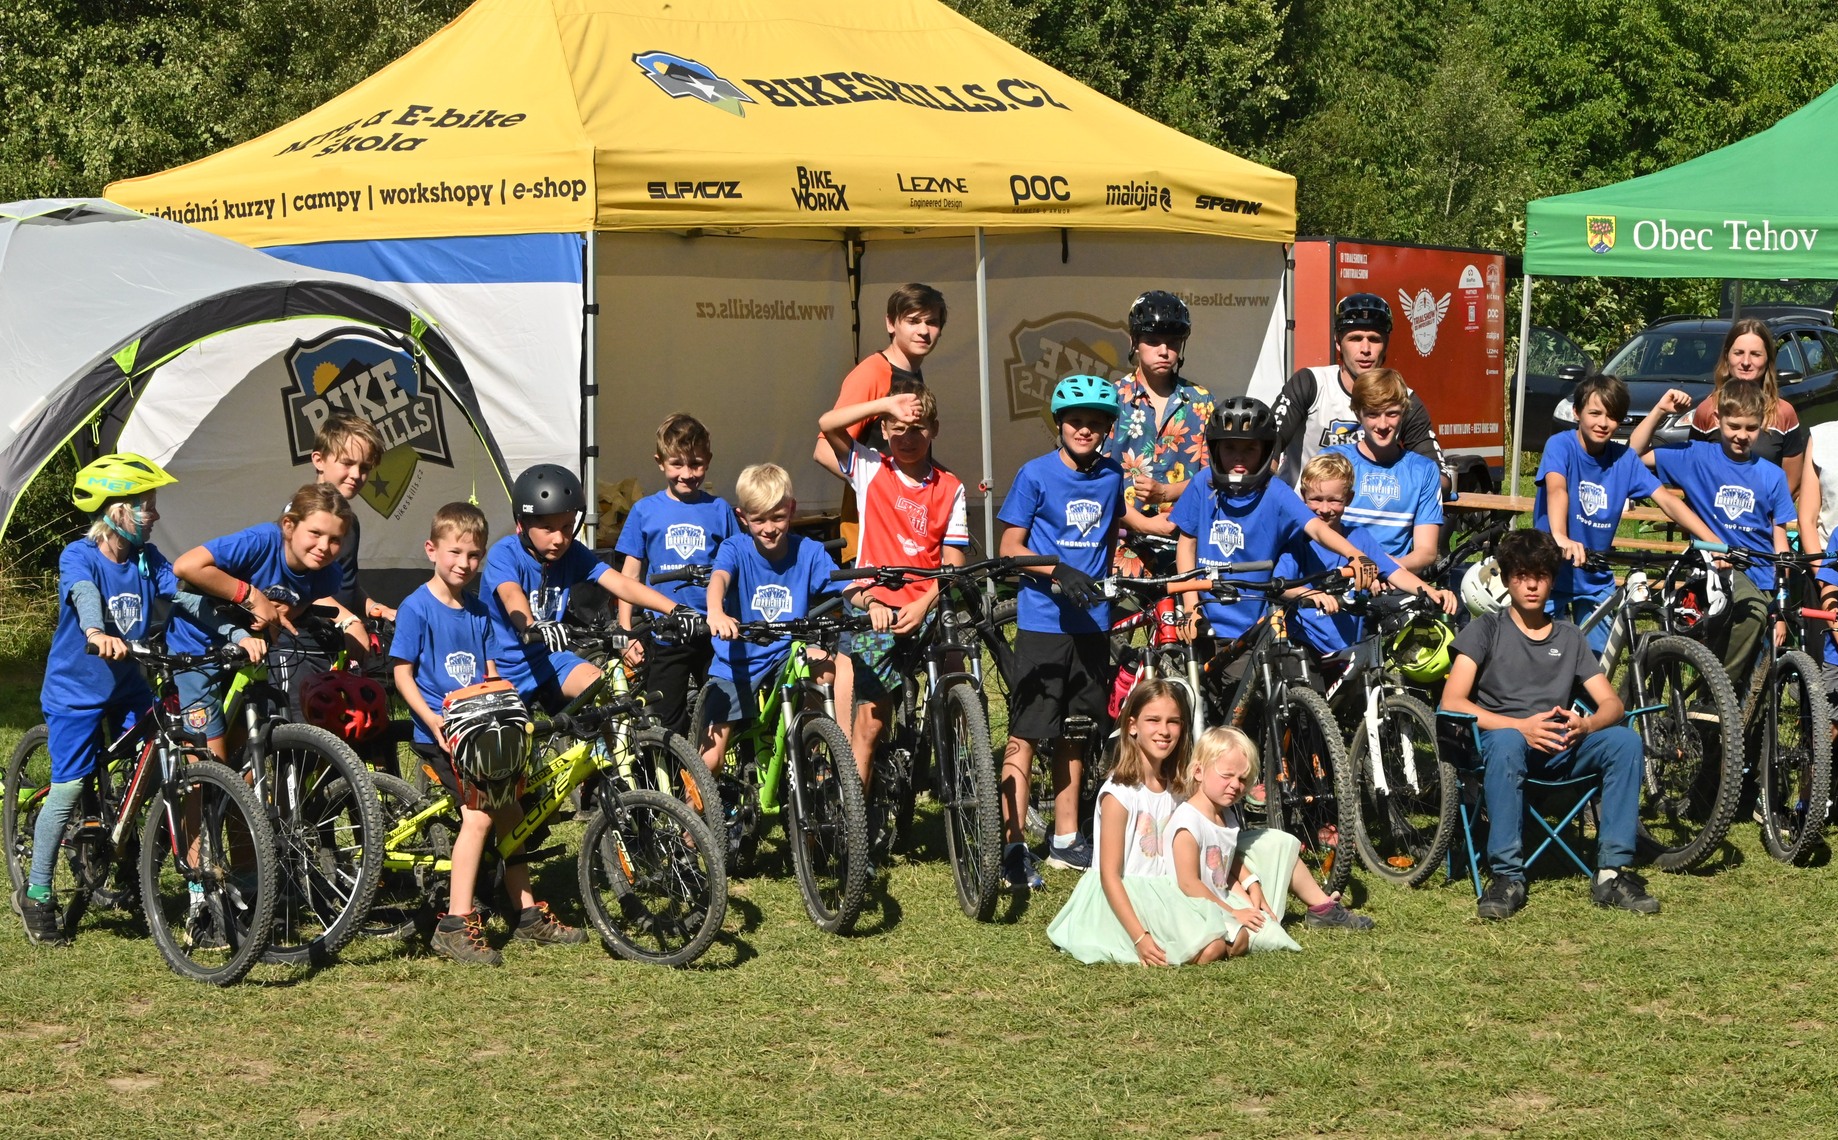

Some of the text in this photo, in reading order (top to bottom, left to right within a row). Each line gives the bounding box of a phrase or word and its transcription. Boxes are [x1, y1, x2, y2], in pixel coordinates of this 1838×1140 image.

[362, 108, 390, 130] a
[392, 104, 529, 130] E-bike
[312, 131, 428, 159] škola
[647, 180, 743, 200] SUPACAZ
[796, 166, 837, 190] BIKE
[896, 172, 969, 195] LEZYNE
[222, 198, 276, 220] kurzy
[292, 188, 362, 213] campy
[380, 179, 492, 207] workshopy
[511, 175, 588, 203] e-shop
[791, 184, 850, 212] WORKX
[909, 197, 964, 210] Engineered Design
[1105, 180, 1158, 211] maloja
[1633, 219, 1820, 252] Obec Tehov
[87, 476, 137, 493] MET
[394, 467, 424, 522] bikeskills.cz
[528, 758, 565, 786] NIPPER
